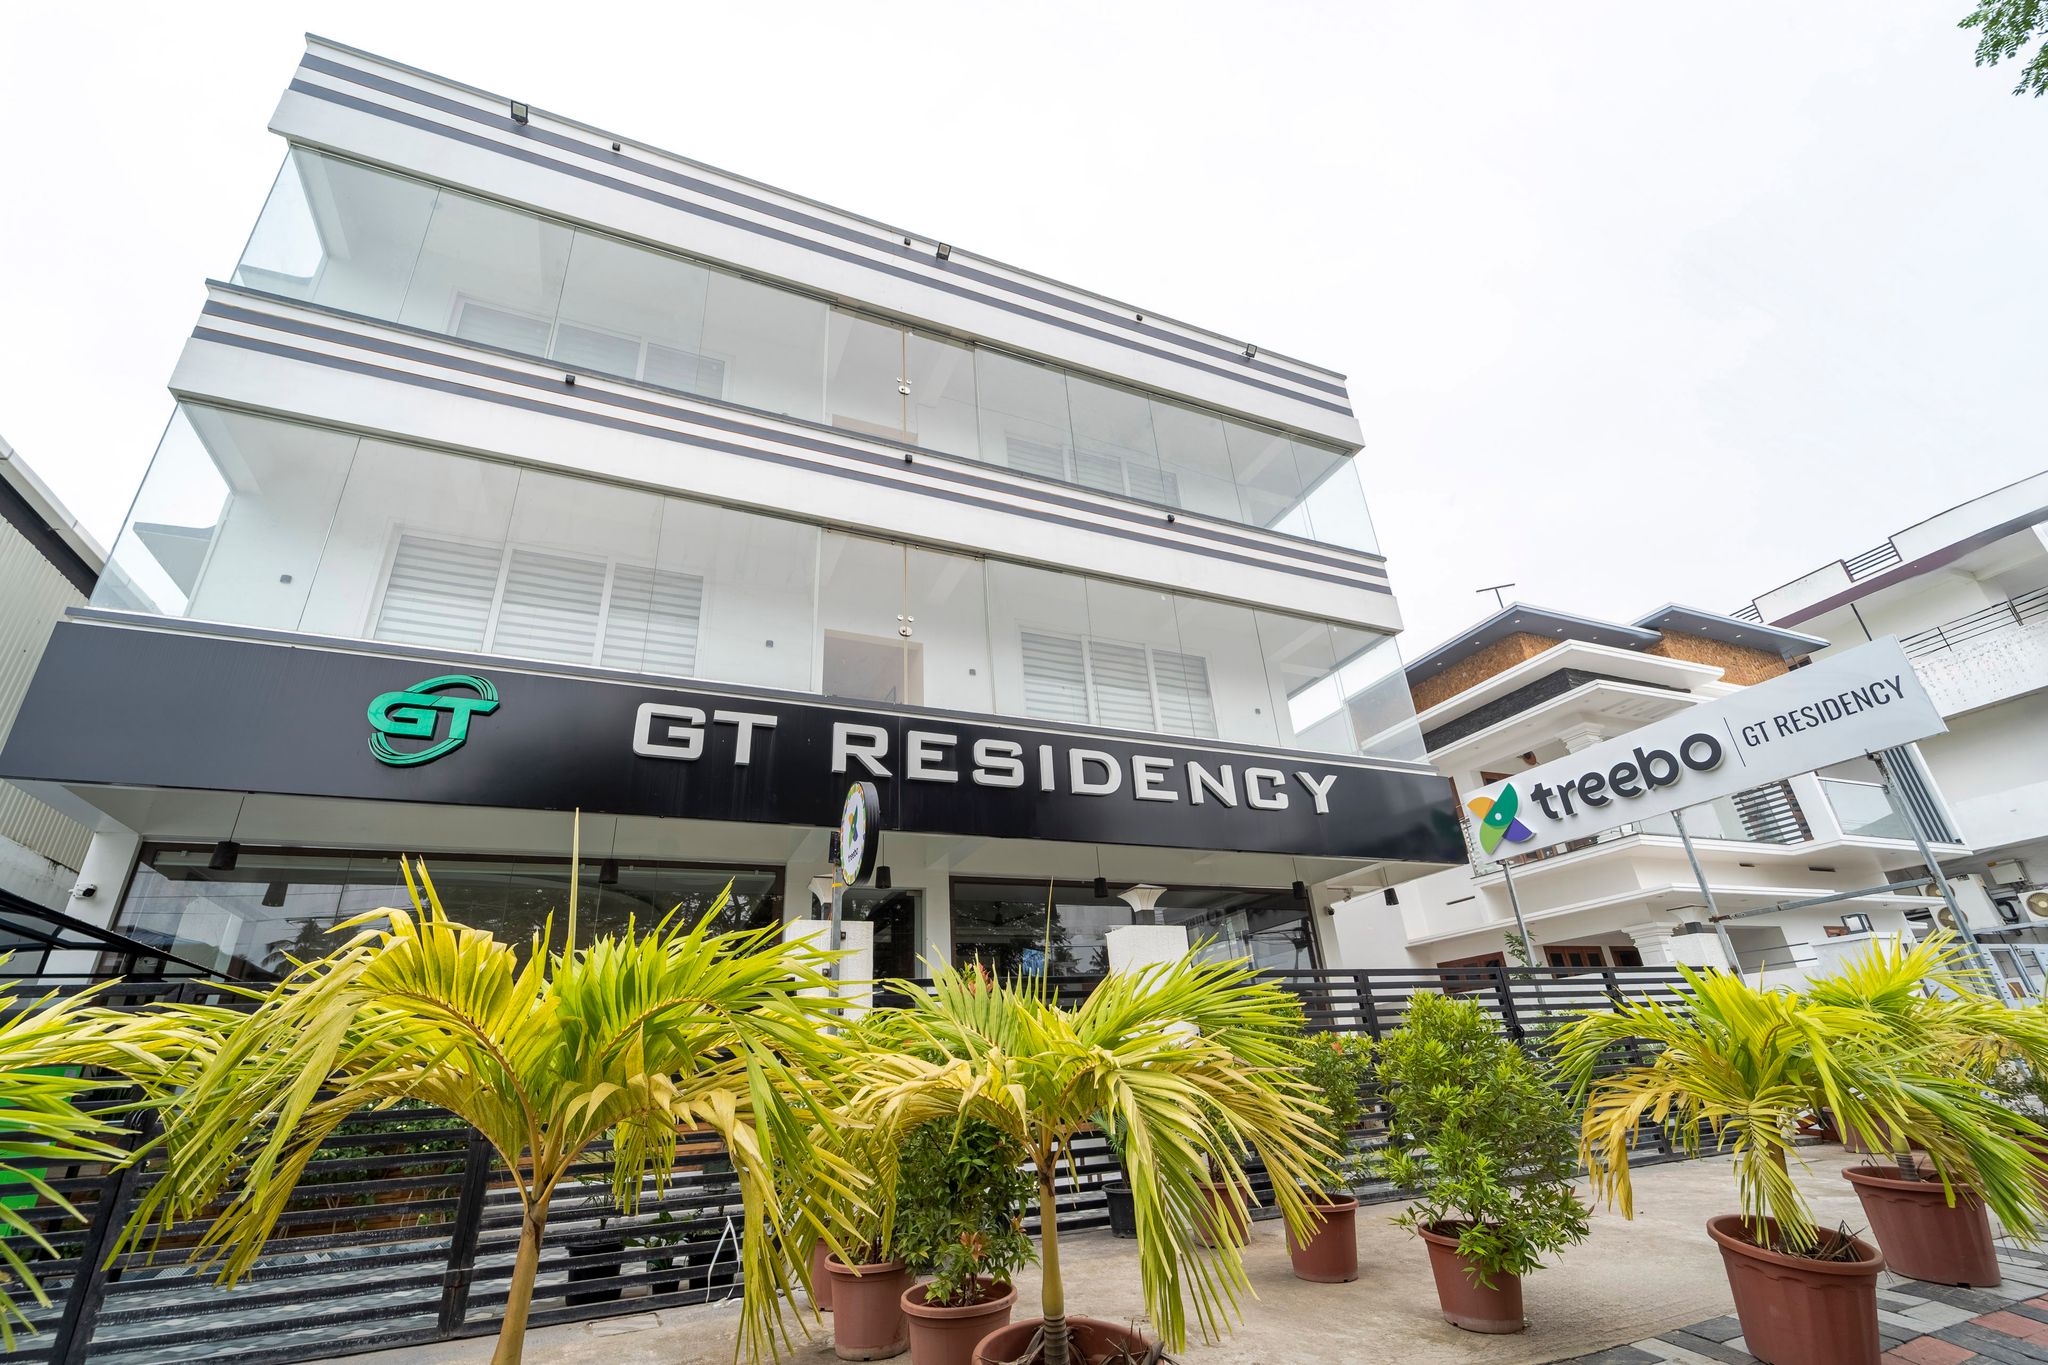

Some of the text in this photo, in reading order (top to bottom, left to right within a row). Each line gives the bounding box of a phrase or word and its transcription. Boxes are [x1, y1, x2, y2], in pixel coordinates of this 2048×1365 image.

[367, 690, 500, 743] GT
[1741, 674, 1906, 748] GT RESIDENCY
[632, 702, 1338, 815] GT RESIDENCY
[1530, 732, 1727, 822] treebo
